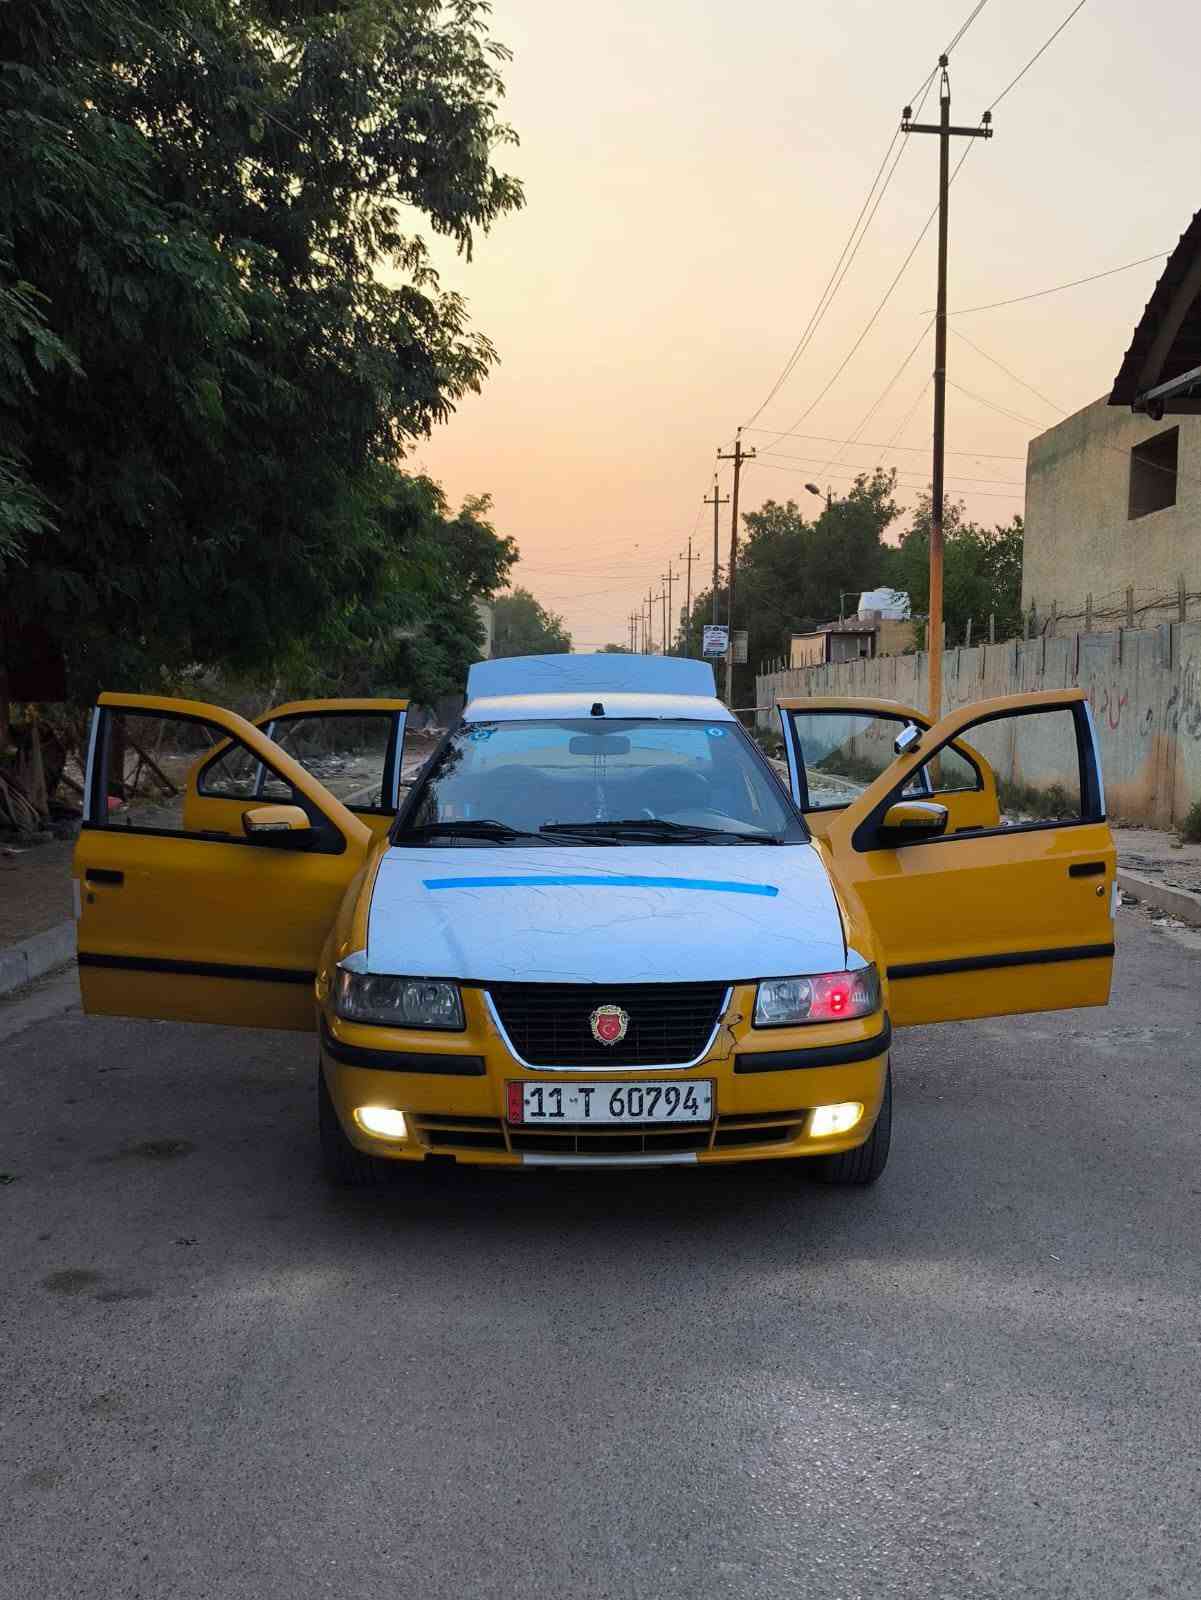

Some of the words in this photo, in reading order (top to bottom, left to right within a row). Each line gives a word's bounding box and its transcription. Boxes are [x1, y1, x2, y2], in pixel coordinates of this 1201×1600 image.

[530, 1087, 565, 1117] 11
[578, 1087, 595, 1117] T
[609, 1086, 699, 1117] 60794
